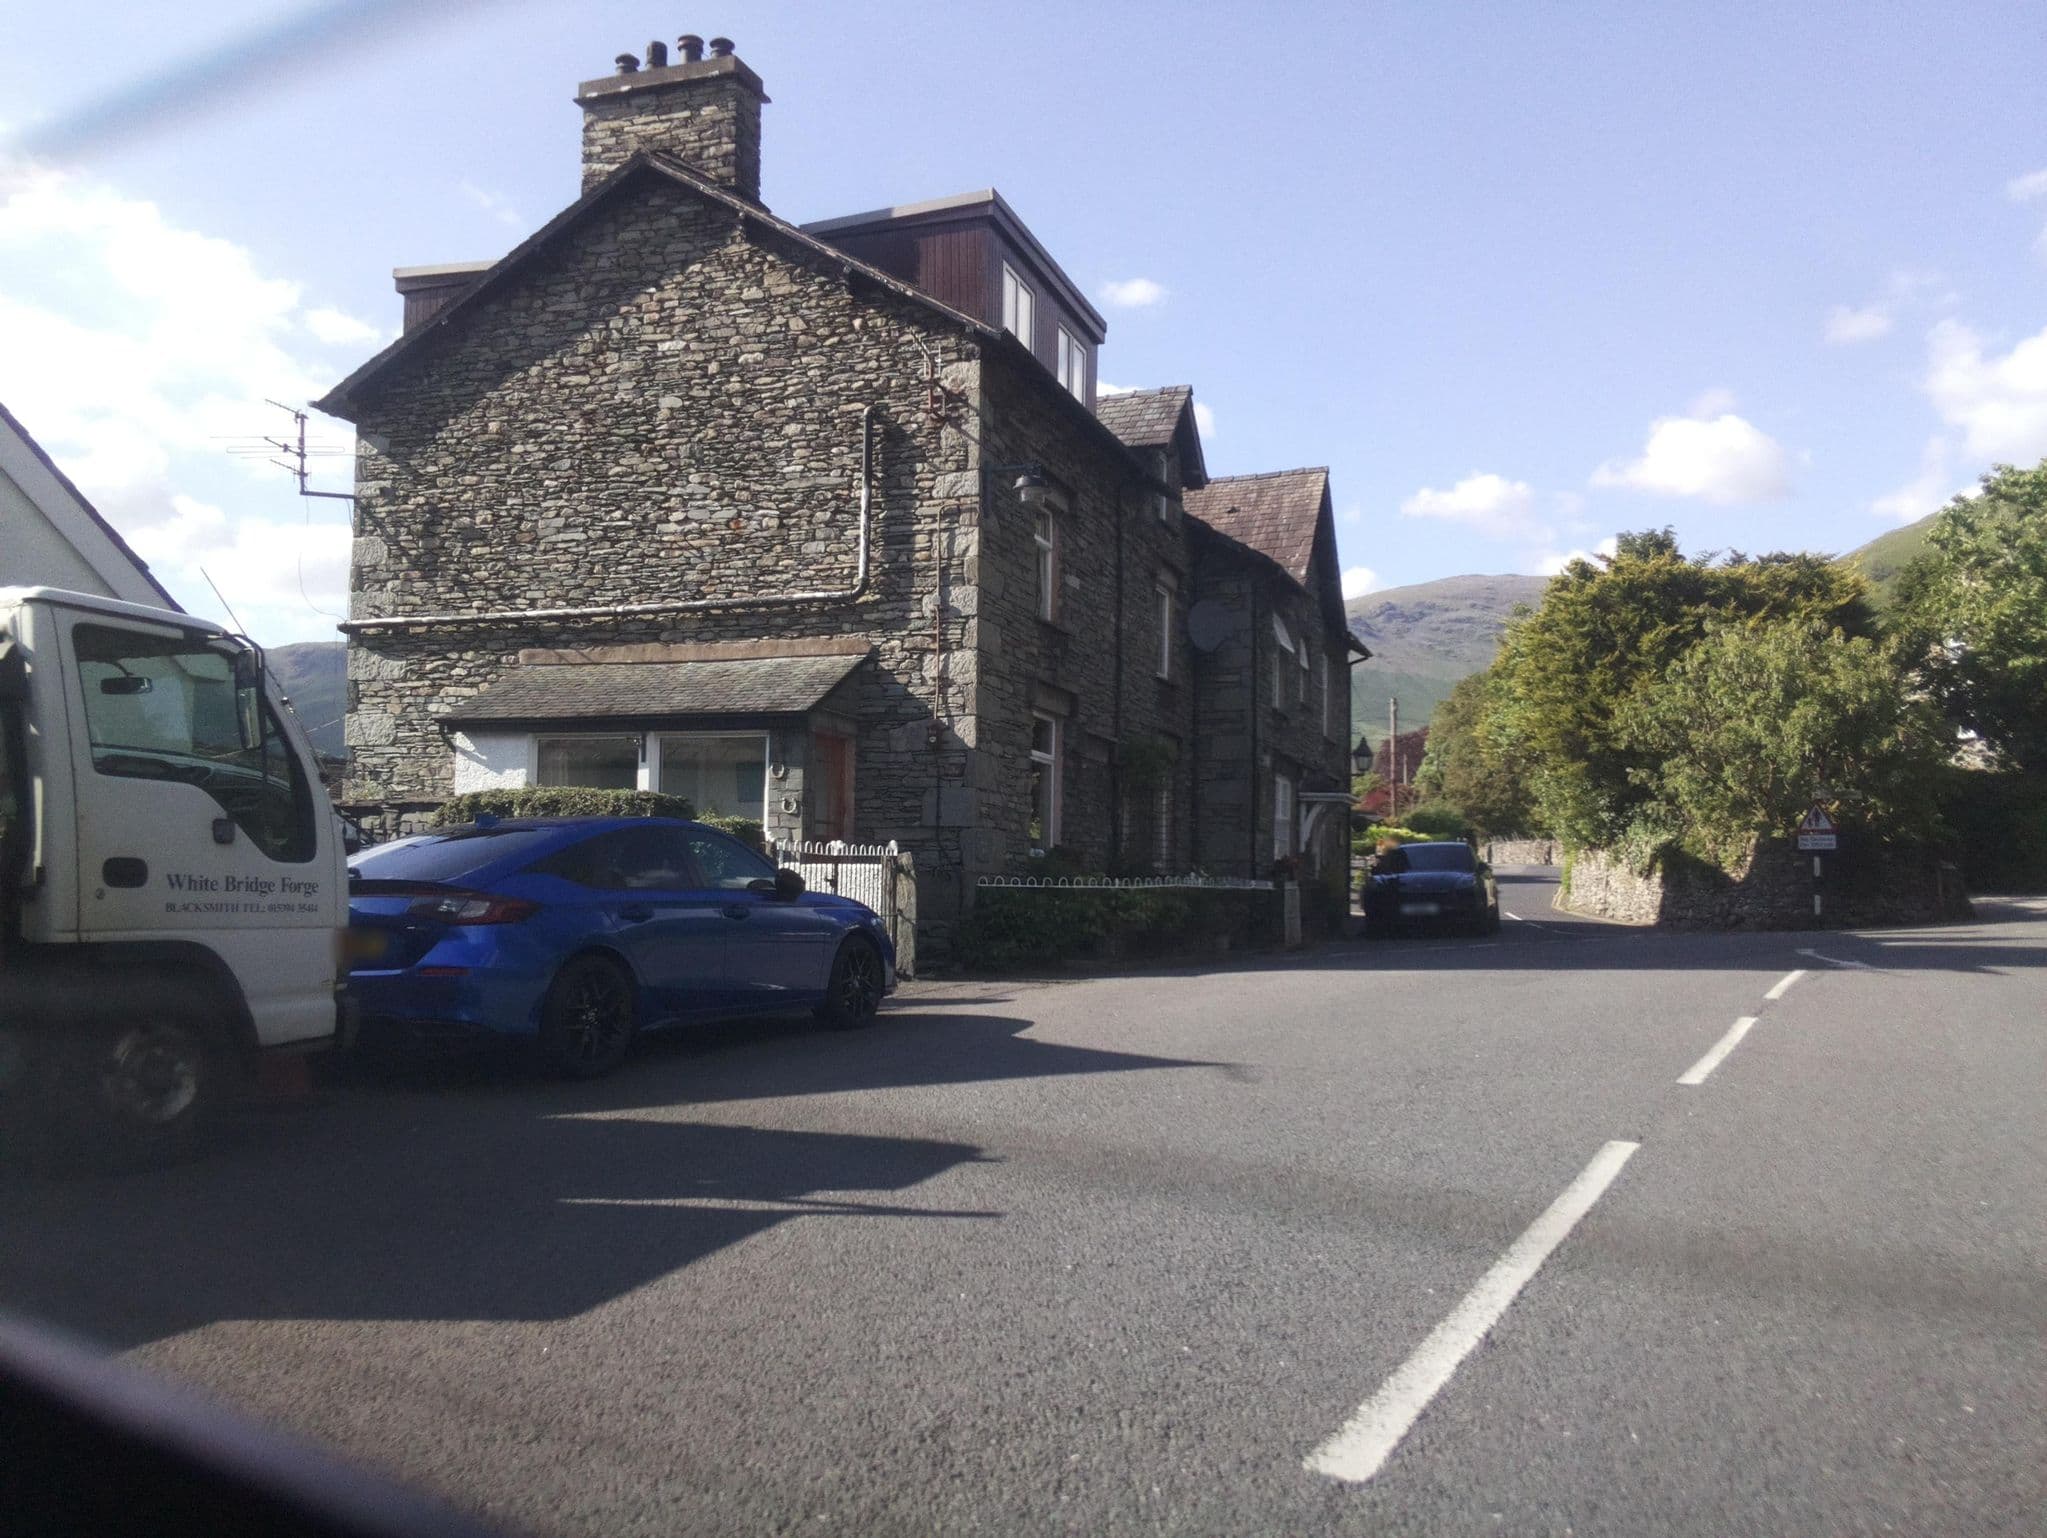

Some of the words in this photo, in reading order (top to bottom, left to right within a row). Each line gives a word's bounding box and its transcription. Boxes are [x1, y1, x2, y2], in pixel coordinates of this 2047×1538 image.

[166, 873, 218, 892] White
[224, 875, 276, 897] Bridge
[281, 877, 320, 898] Forge
[165, 902, 239, 913] BLACKSMITH
